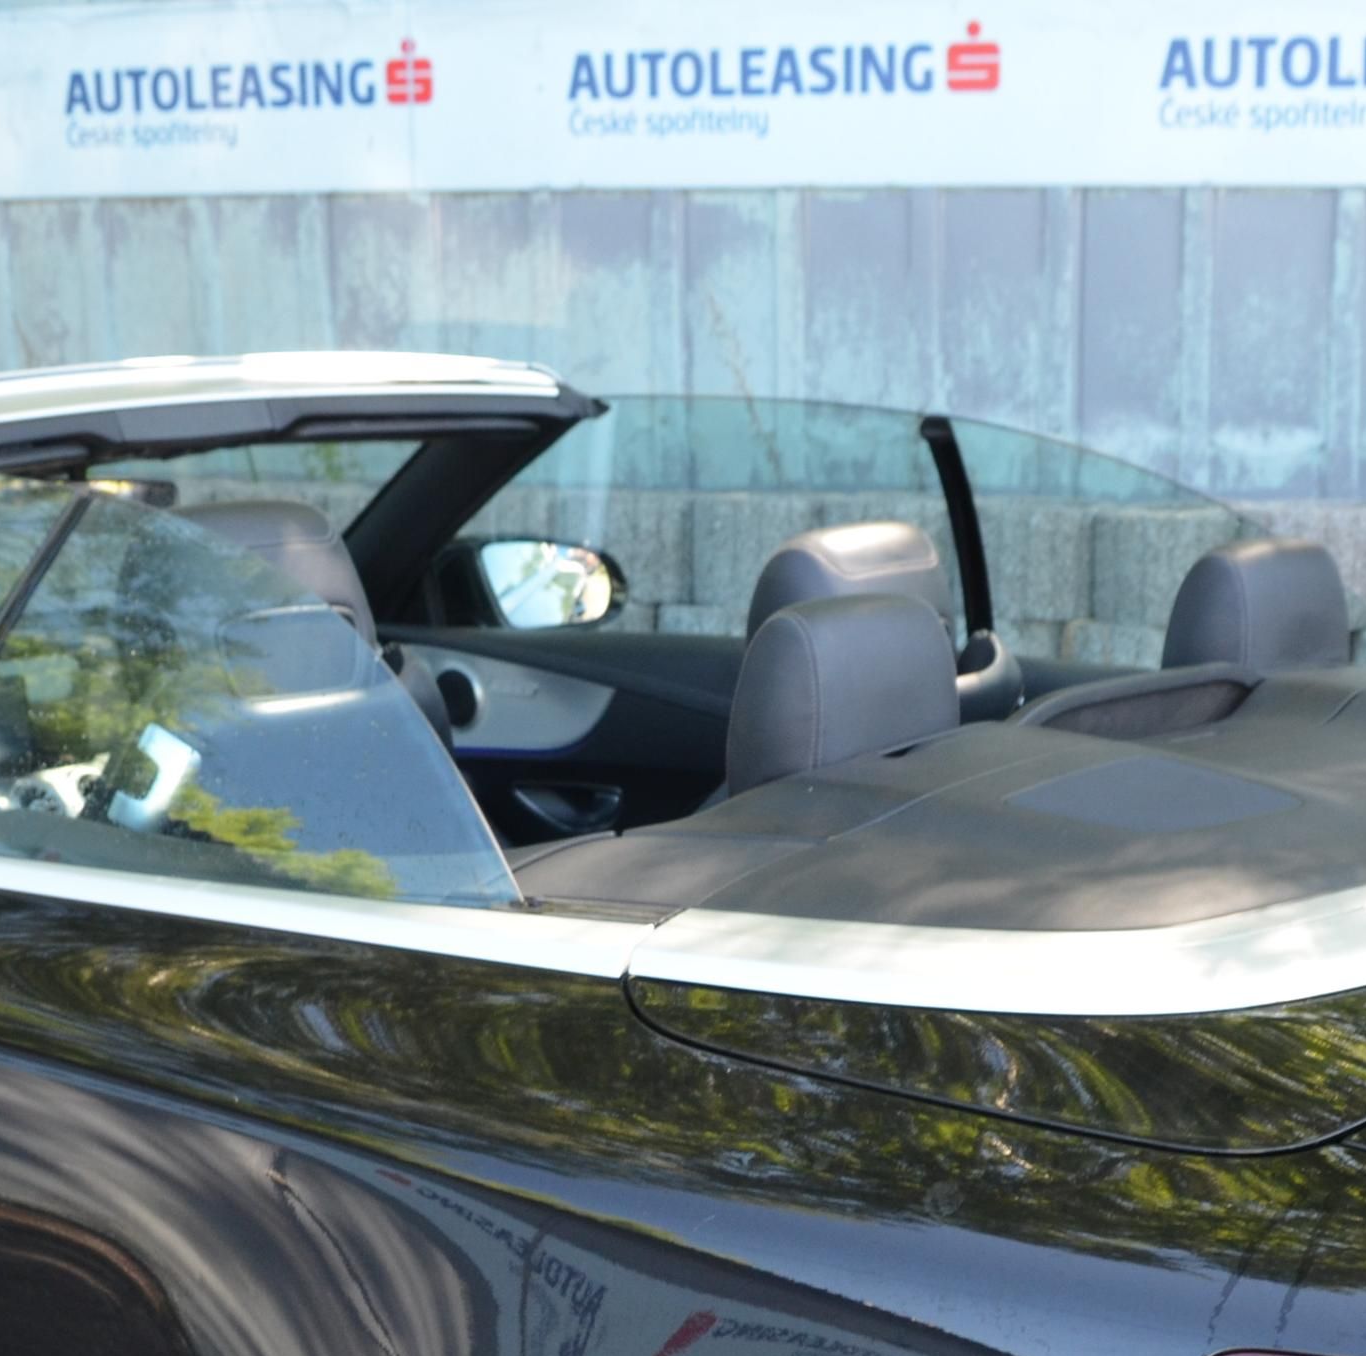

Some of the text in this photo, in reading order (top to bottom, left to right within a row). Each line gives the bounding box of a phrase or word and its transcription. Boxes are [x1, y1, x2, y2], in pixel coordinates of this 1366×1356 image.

[65, 58, 376, 116] AUTOLEASING
[568, 43, 934, 100] AUTOLEASING
[568, 105, 770, 139] České spořitelny
[1158, 95, 1239, 130] České
